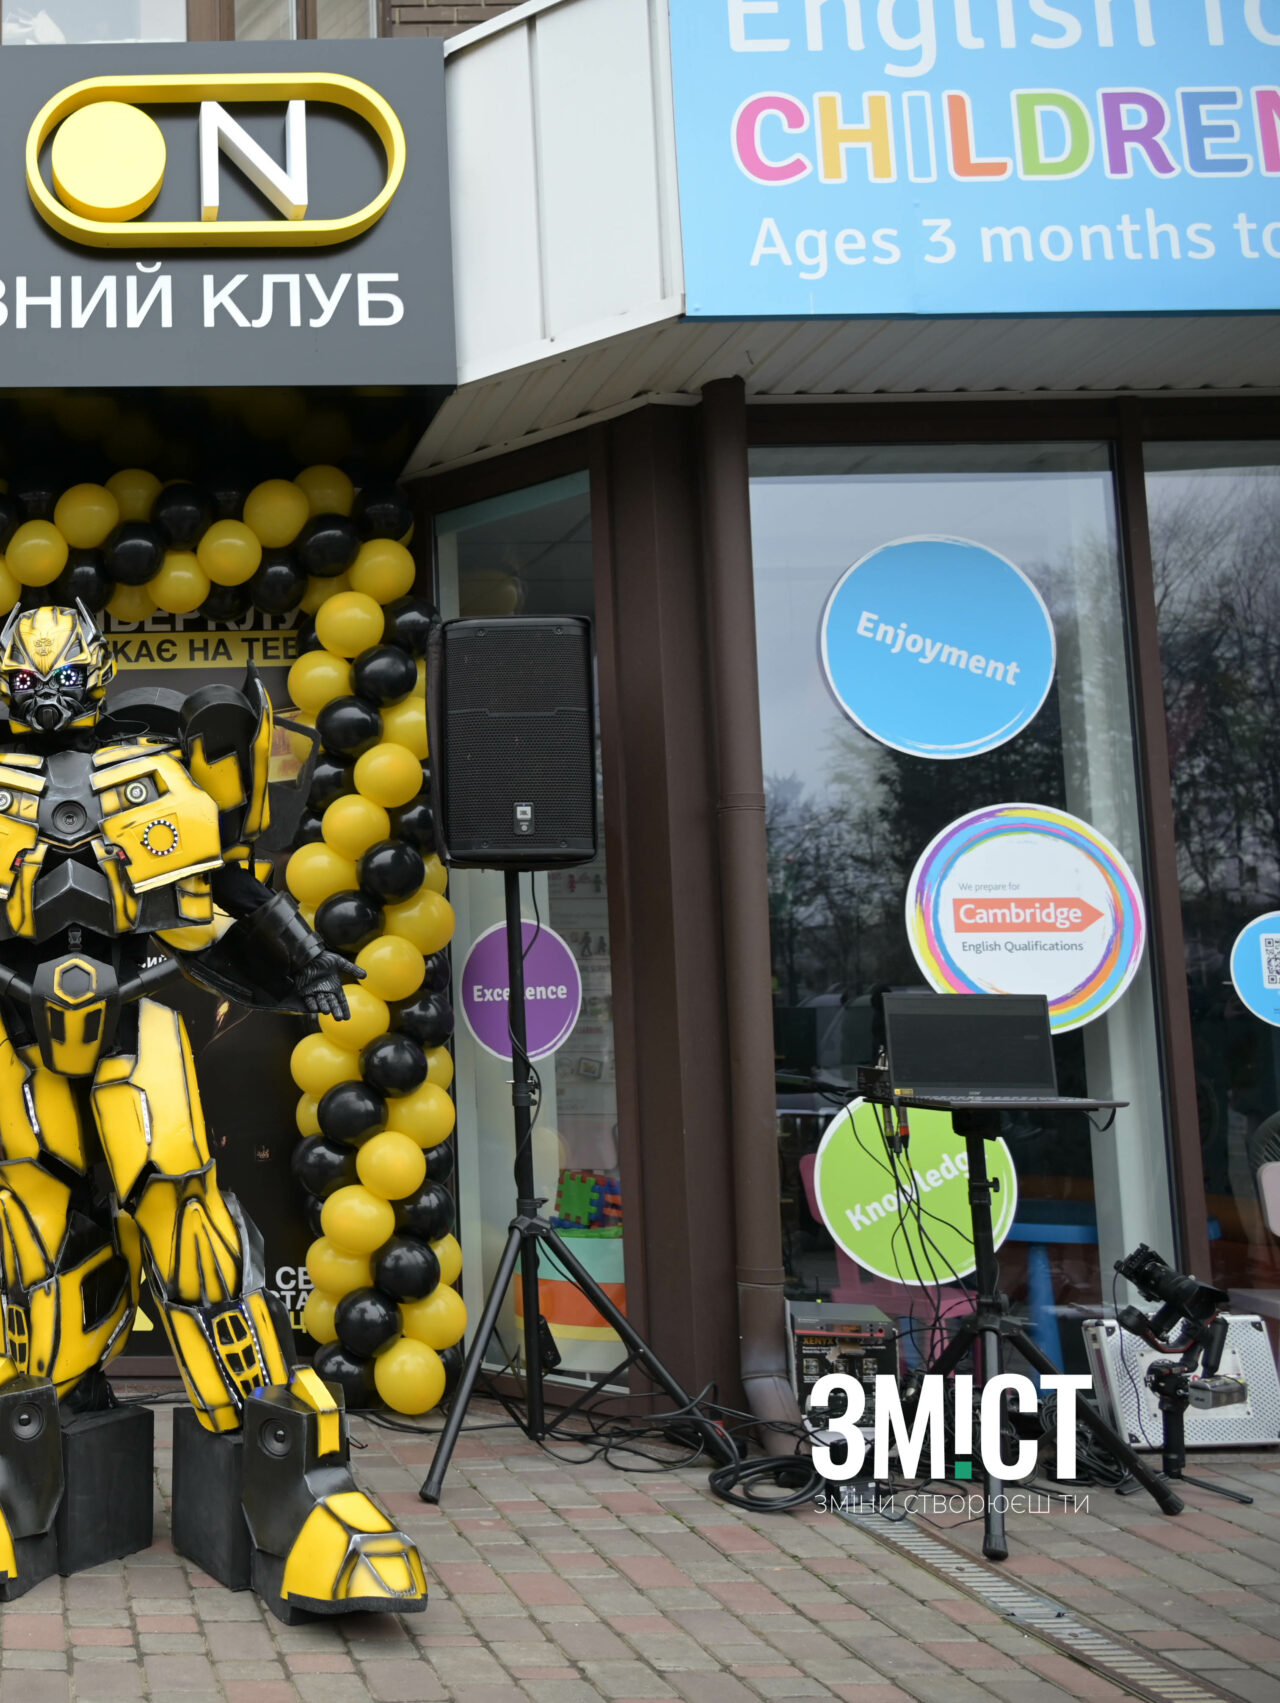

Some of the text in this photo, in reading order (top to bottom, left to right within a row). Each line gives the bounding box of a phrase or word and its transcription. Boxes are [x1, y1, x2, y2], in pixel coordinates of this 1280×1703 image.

[749, 218, 901, 280] Ages
[921, 218, 956, 264] 3
[980, 208, 1216, 263] months
[203, 272, 404, 328] КЛУБ
[107, 639, 177, 662] КАЄ
[189, 638, 232, 661] НА
[856, 611, 1021, 686] Enjoyment
[959, 882, 1020, 892] We prepare for
[960, 902, 1082, 928] Cambridge
[962, 940, 1084, 954] English Qualifications
[473, 985, 568, 1002] Exceence
[845, 1150, 988, 1231] Knowledg
